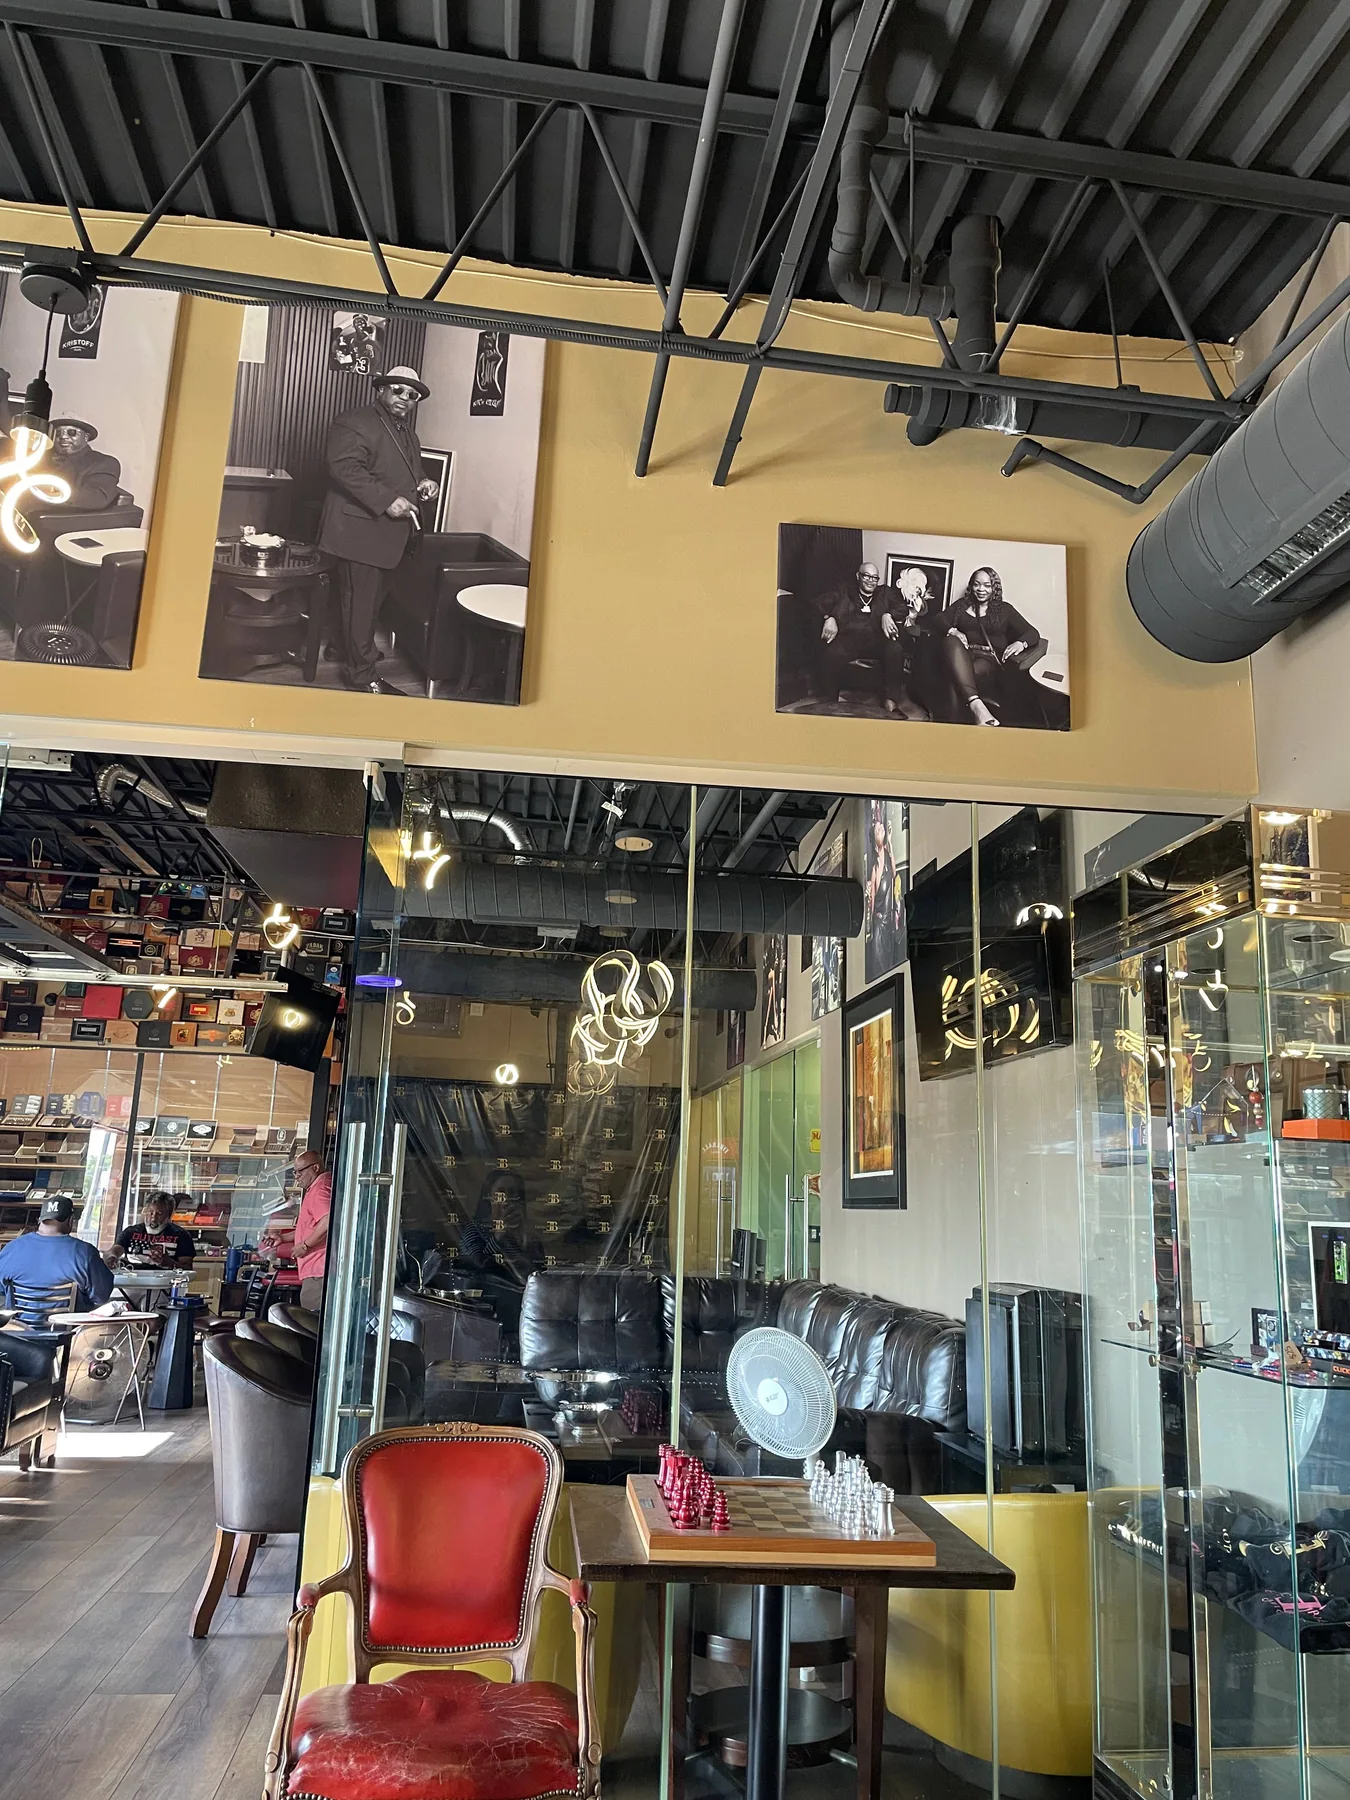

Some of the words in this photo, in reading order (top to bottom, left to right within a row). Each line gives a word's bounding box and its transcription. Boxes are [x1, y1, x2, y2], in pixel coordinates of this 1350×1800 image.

[62, 339, 95, 349] KRISTOFF
[47, 1201, 59, 1212] M
[132, 1232, 178, 1243] OUTKAST
